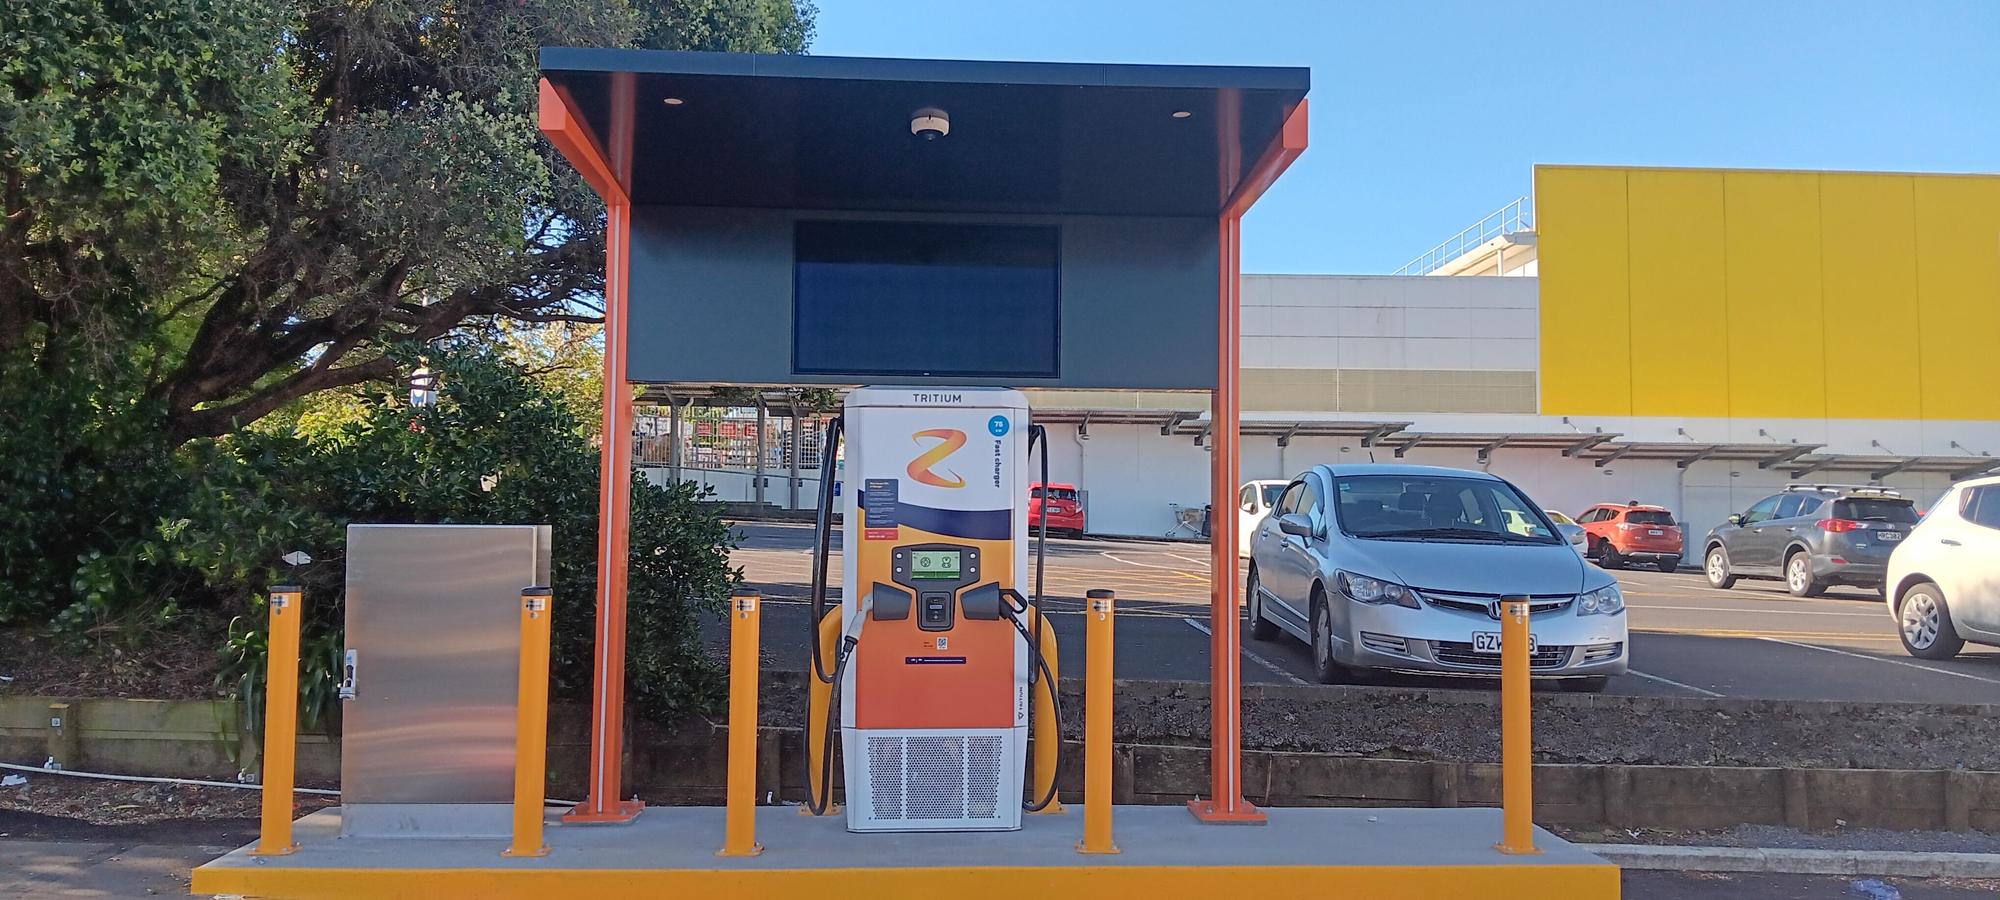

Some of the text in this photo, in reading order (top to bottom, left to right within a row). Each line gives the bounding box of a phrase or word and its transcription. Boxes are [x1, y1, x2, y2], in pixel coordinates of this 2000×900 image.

[912, 393, 962, 403] TRITIUM
[994, 439, 1002, 457] Fast
[993, 457, 1002, 488] charger
